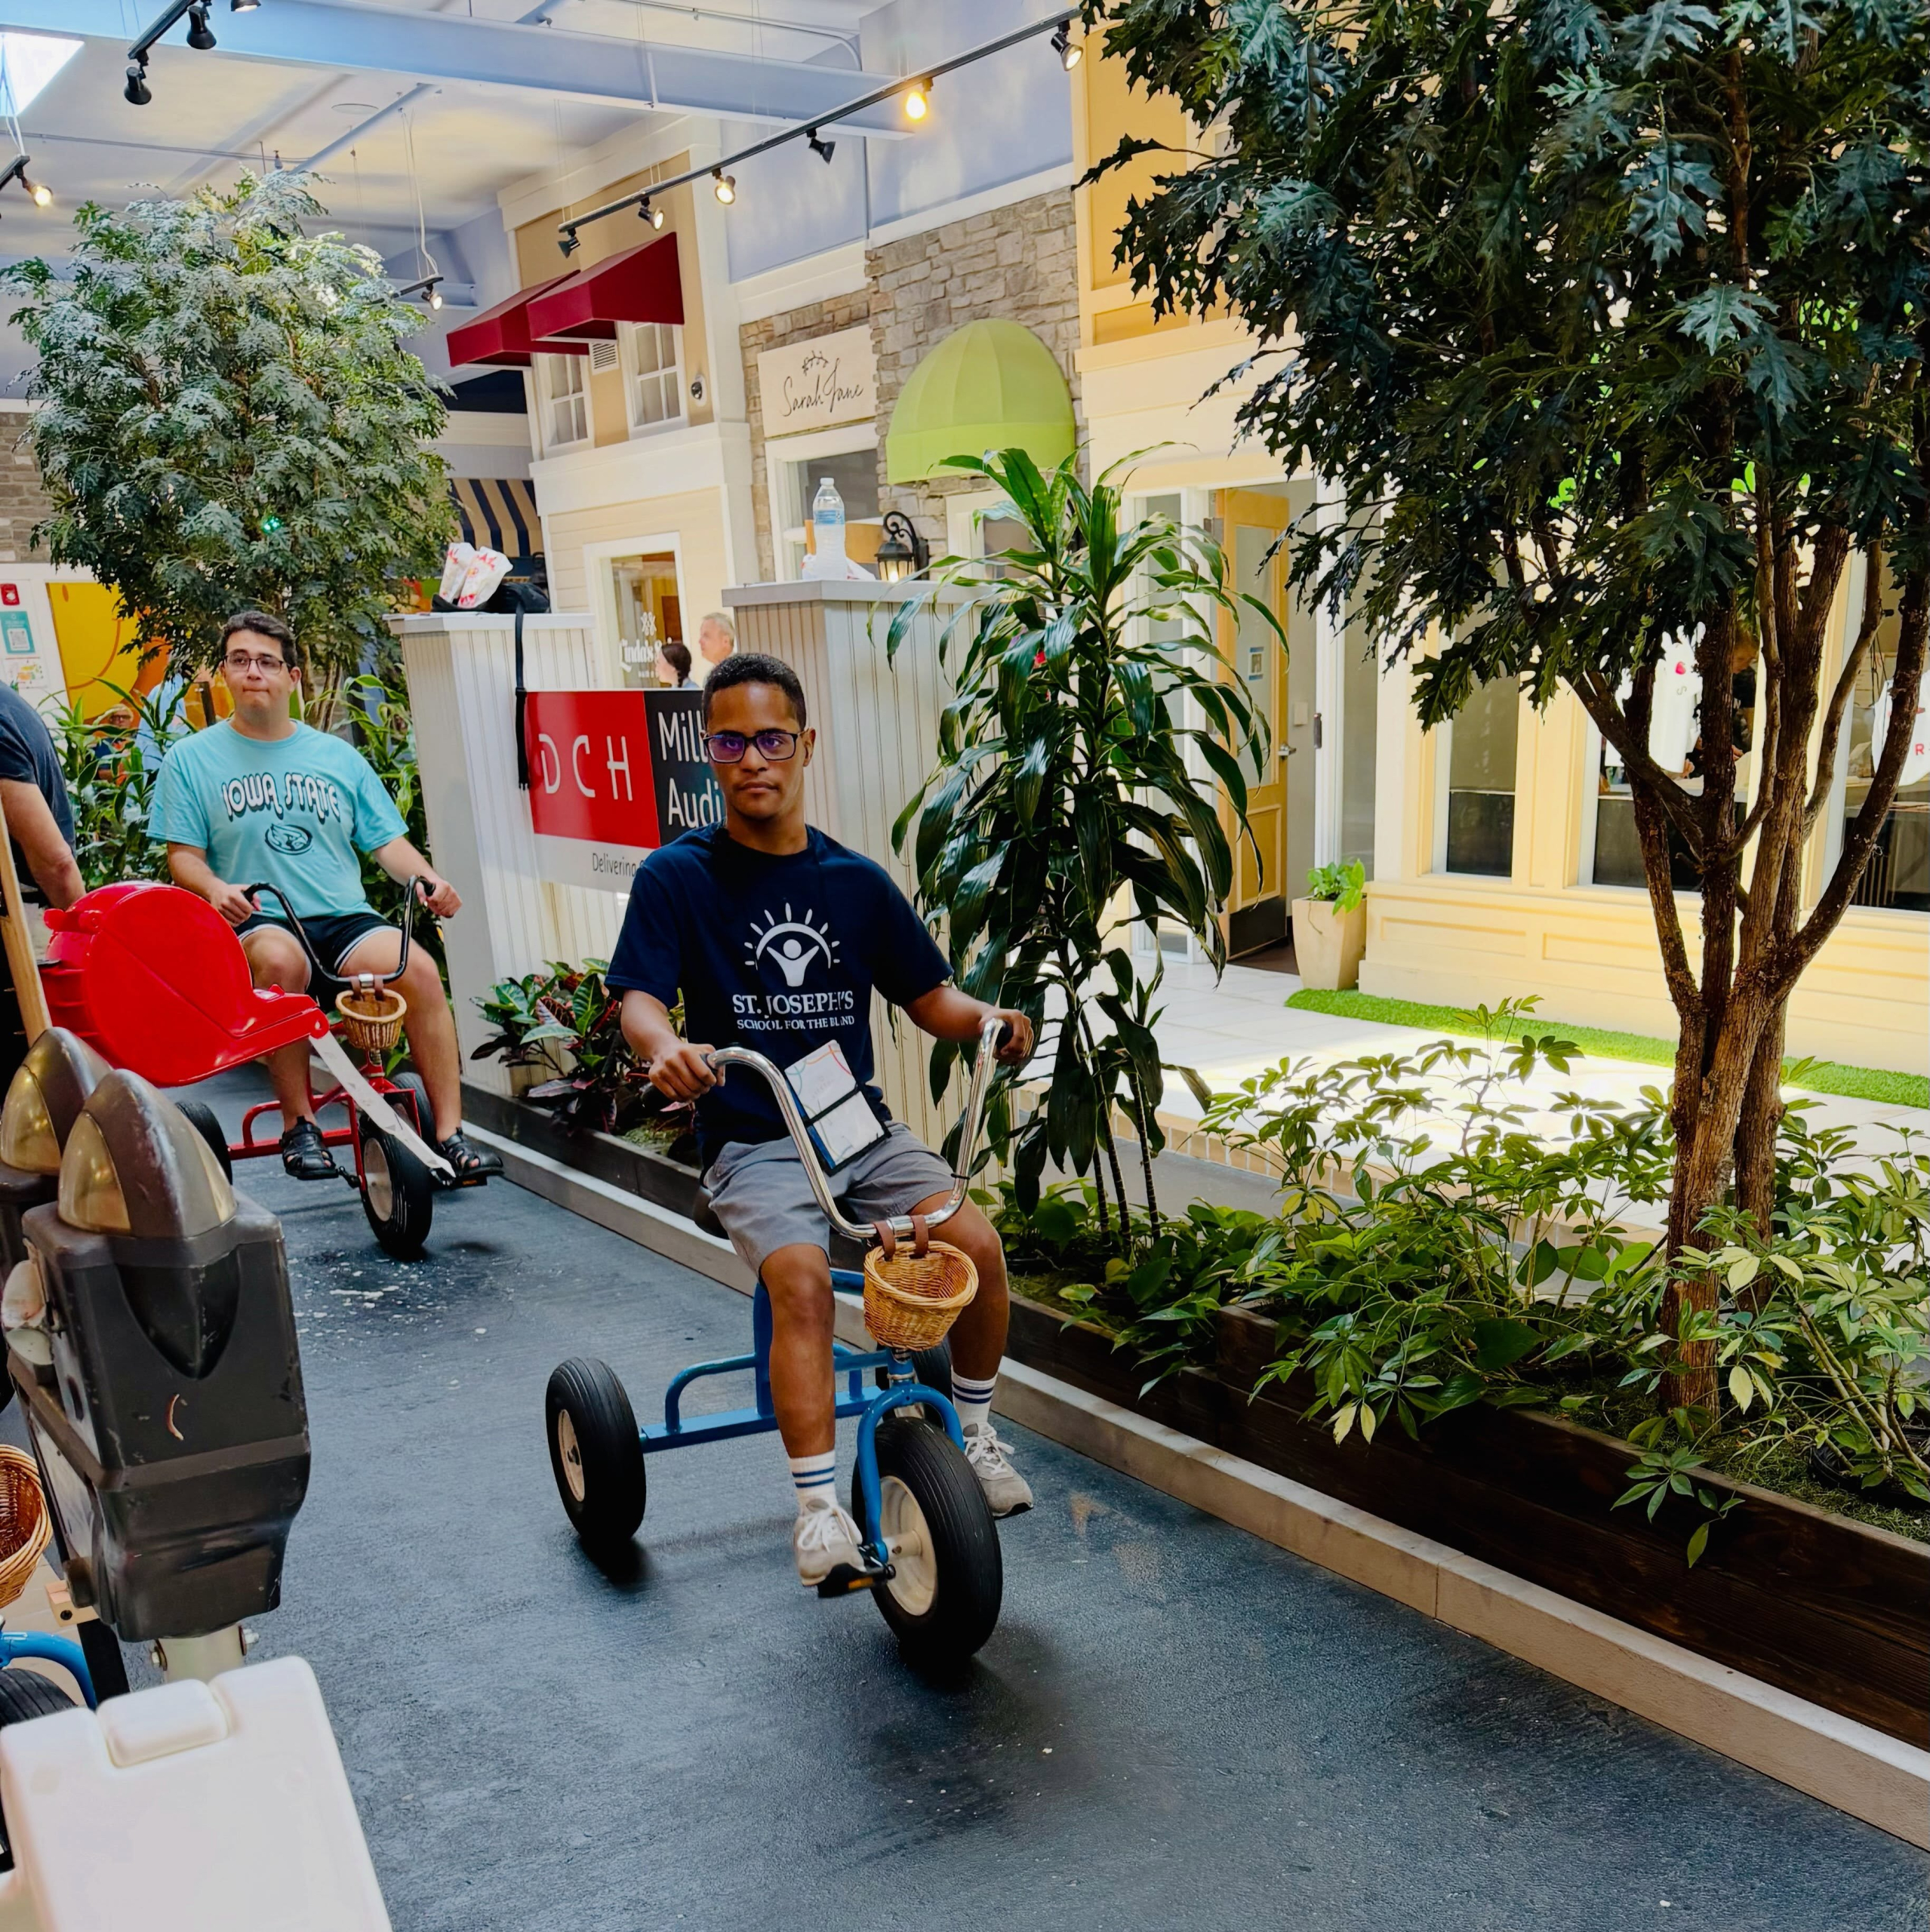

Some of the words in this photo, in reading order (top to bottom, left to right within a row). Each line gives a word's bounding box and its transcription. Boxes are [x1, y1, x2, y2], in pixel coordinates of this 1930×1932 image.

[781, 374, 823, 417] Sarah
[822, 358, 863, 413] Jane
[222, 772, 284, 823] IOWA
[285, 772, 340, 825] STATE
[668, 777, 722, 829] Audi
[732, 994, 762, 1014] ST.
[765, 990, 854, 1019] JOSEPH'S
[737, 1019, 783, 1030] SCHOOL
[785, 1019, 805, 1029] FOR
[807, 1018, 828, 1029] THE
